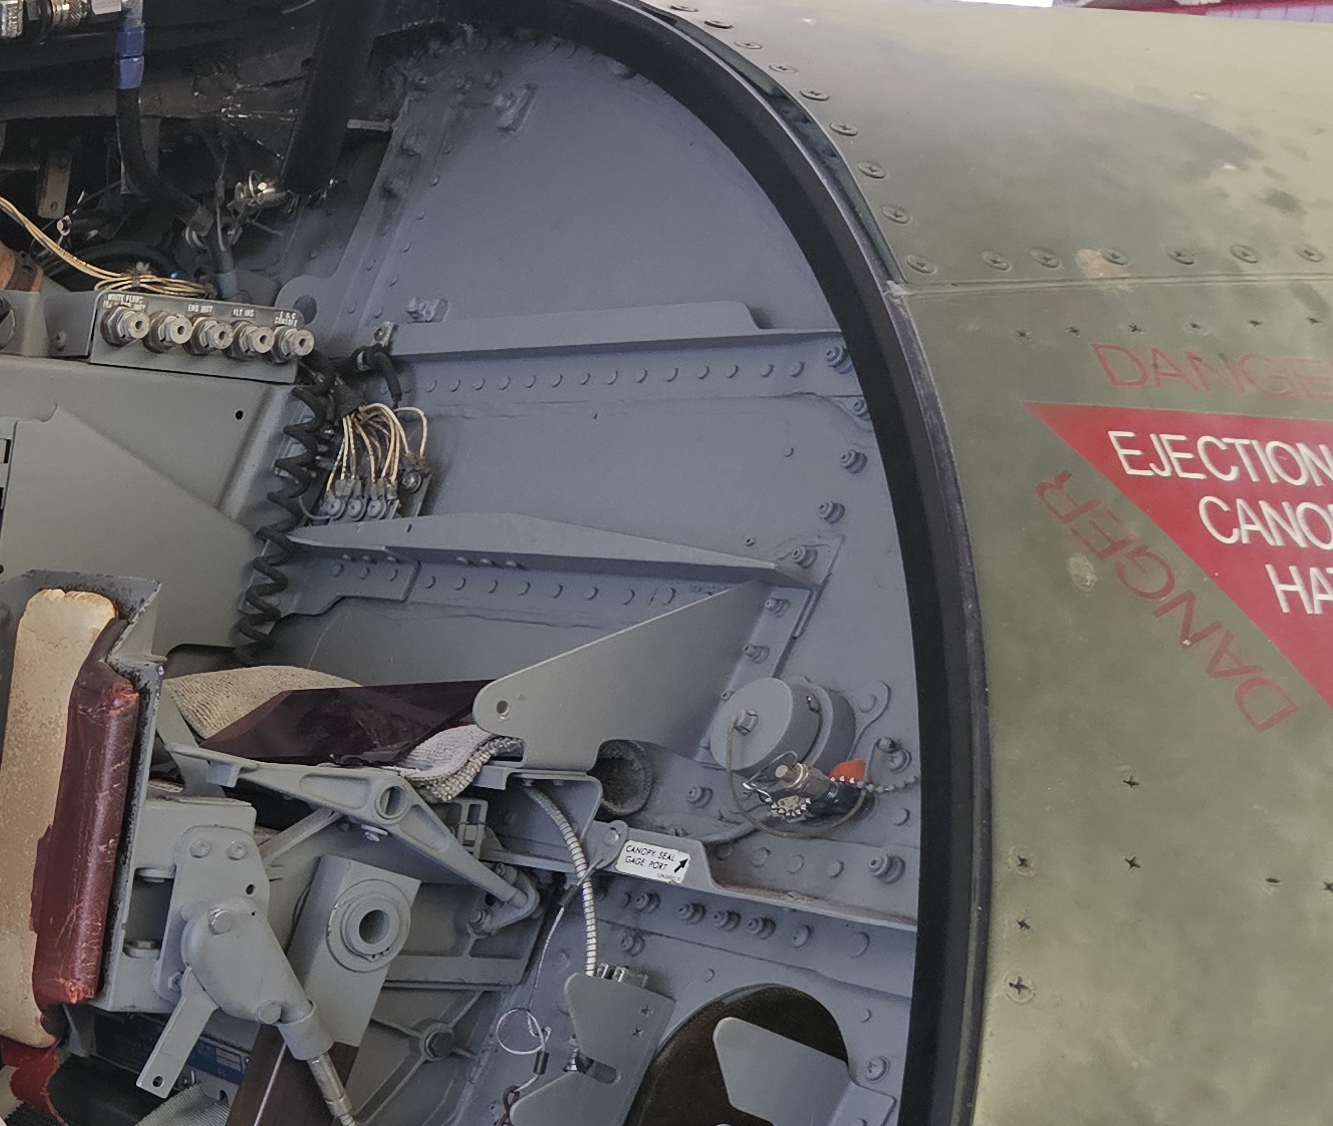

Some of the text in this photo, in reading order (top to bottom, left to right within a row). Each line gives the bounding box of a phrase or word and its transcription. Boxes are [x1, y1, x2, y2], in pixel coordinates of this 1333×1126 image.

[1090, 342, 1333, 402] DANGE
[1108, 431, 1333, 487] EJECTION
[1199, 496, 1333, 550] CANO
[1035, 469, 1299, 734] DANGER
[1265, 564, 1333, 614] HA
[625, 845, 675, 861] CANOPY SEAL
[625, 855, 668, 870] GAGE PORT
